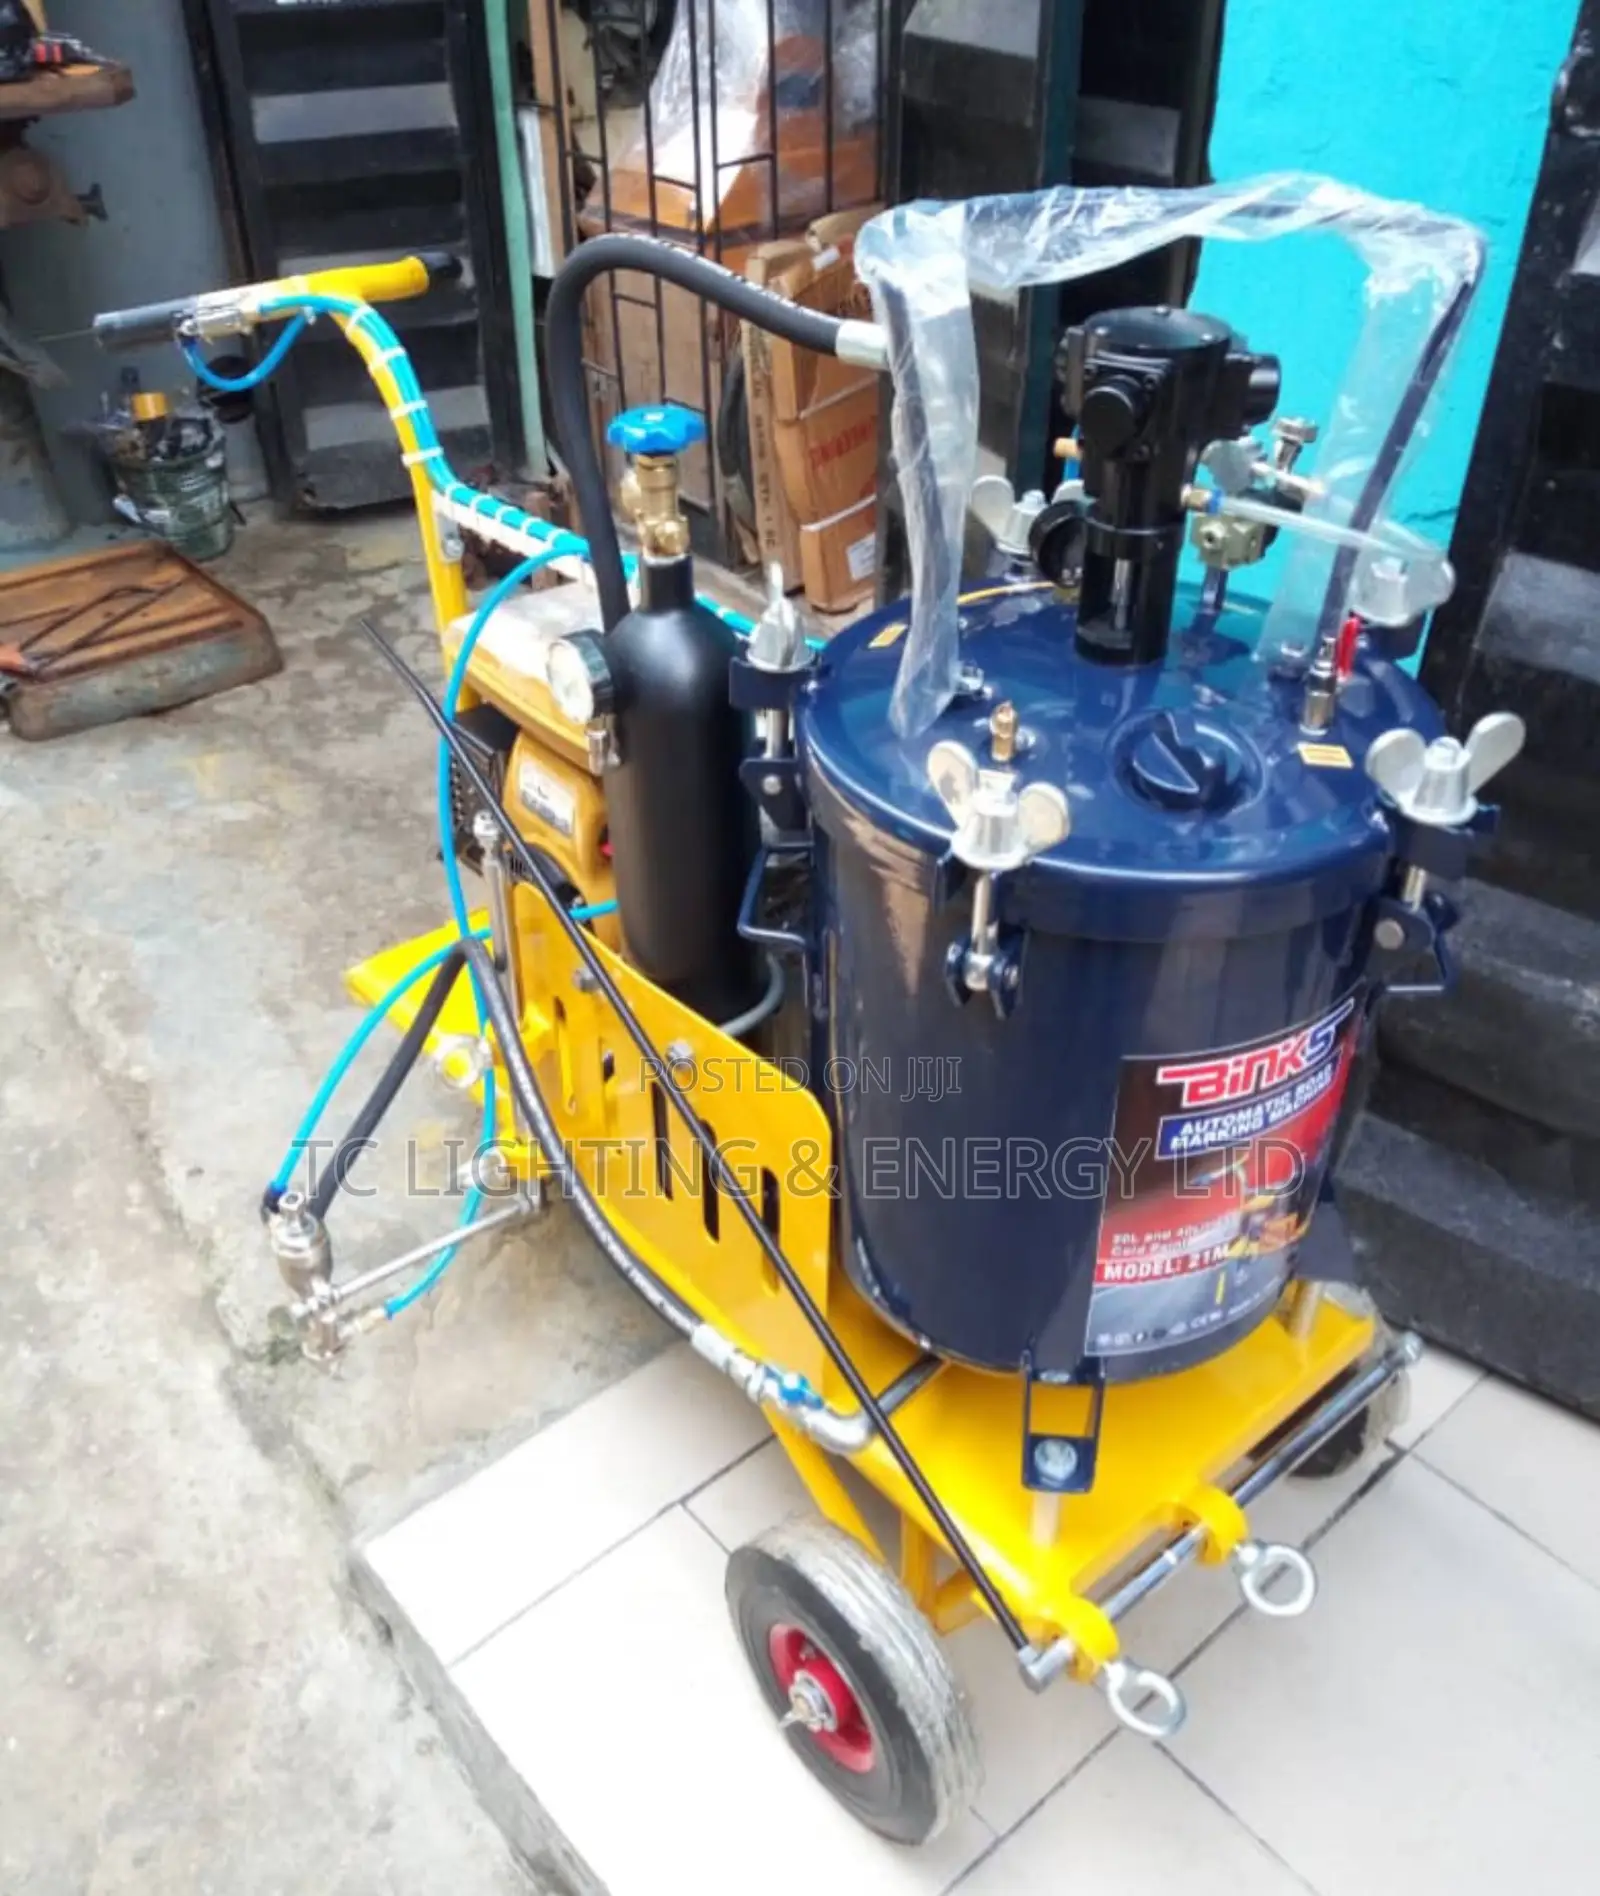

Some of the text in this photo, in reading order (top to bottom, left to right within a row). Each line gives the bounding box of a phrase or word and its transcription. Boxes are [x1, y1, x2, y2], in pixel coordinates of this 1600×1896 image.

[1170, 1111, 1264, 1150] MARKING
[1180, 1091, 1291, 1136] AUTOMATIC
[1104, 1259, 1181, 1280] MODEL:
